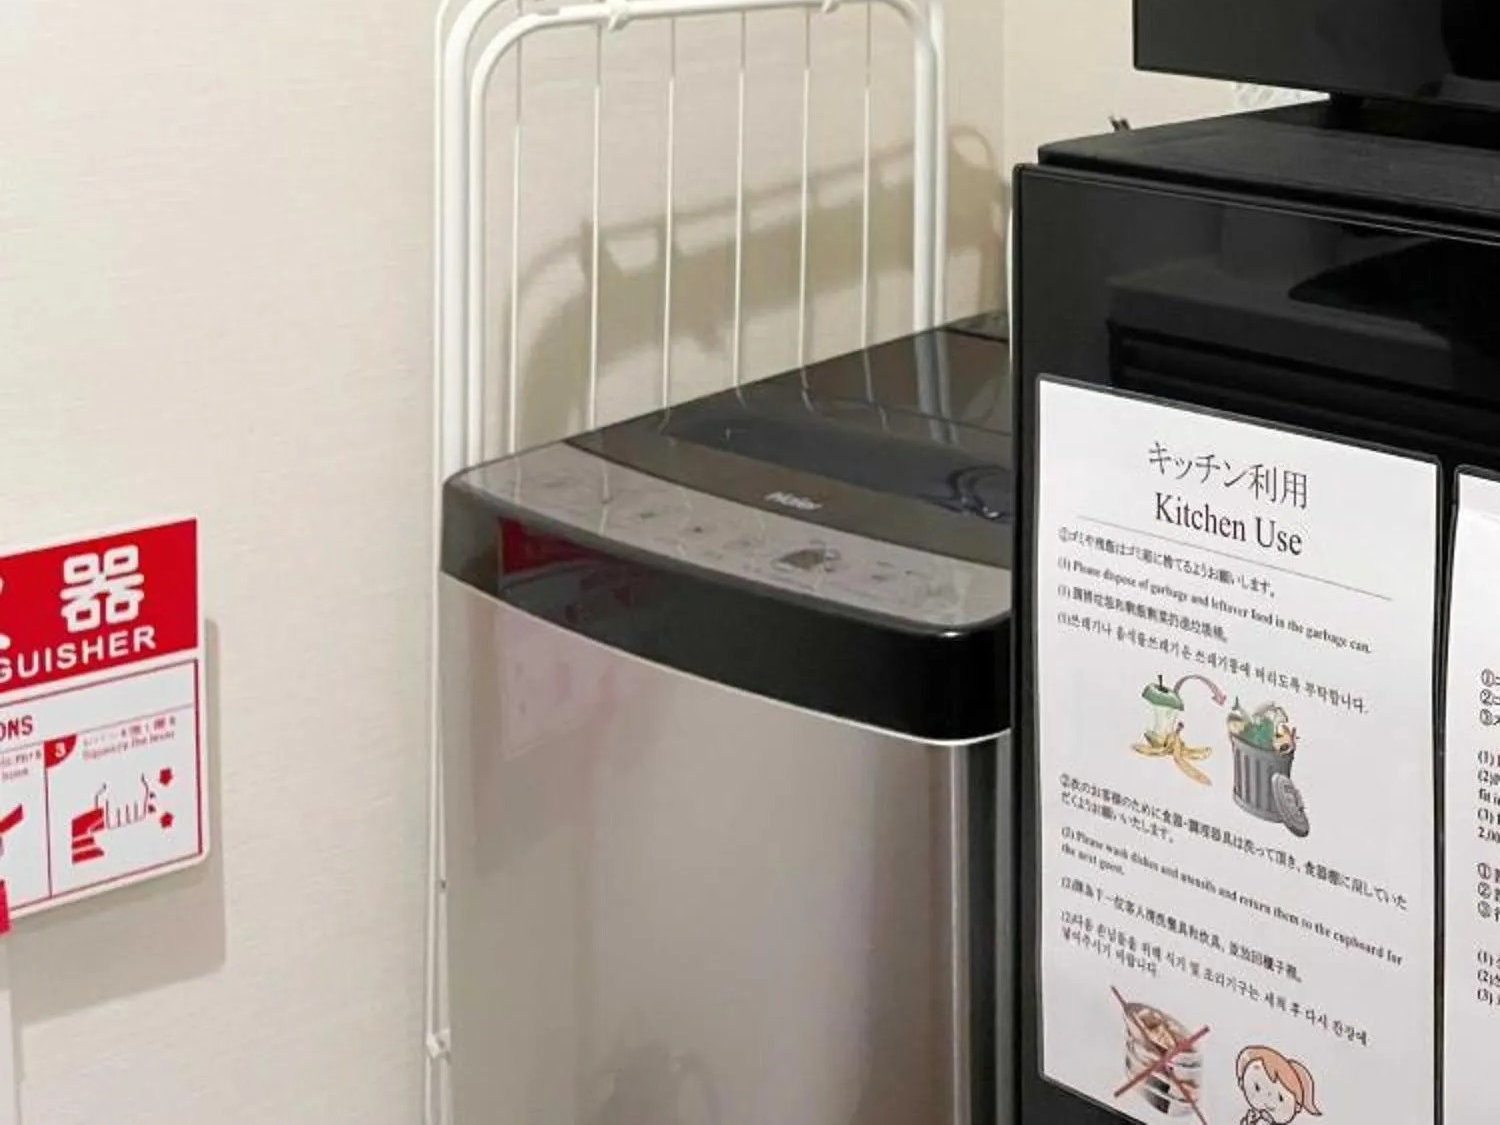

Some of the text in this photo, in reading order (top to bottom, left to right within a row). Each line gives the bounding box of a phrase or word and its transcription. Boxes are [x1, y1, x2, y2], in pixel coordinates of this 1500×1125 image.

[1149, 441, 1308, 510] キッチン利用
[1155, 492, 1303, 556] Kitchen Use
[61, 544, 144, 633] 器
[1189, 594, 1209, 608] and
[1286, 618, 1304, 634] the
[55, 742, 66, 758] 3
[1476, 749, 1495, 768] (1)
[1477, 787, 1491, 803] fit
[1476, 806, 1495, 825] (3)
[1159, 864, 1179, 880] and
[1217, 887, 1237, 902] and
[1300, 917, 1313, 930] to
[1313, 922, 1331, 938] the
[1476, 949, 1494, 967] (1)
